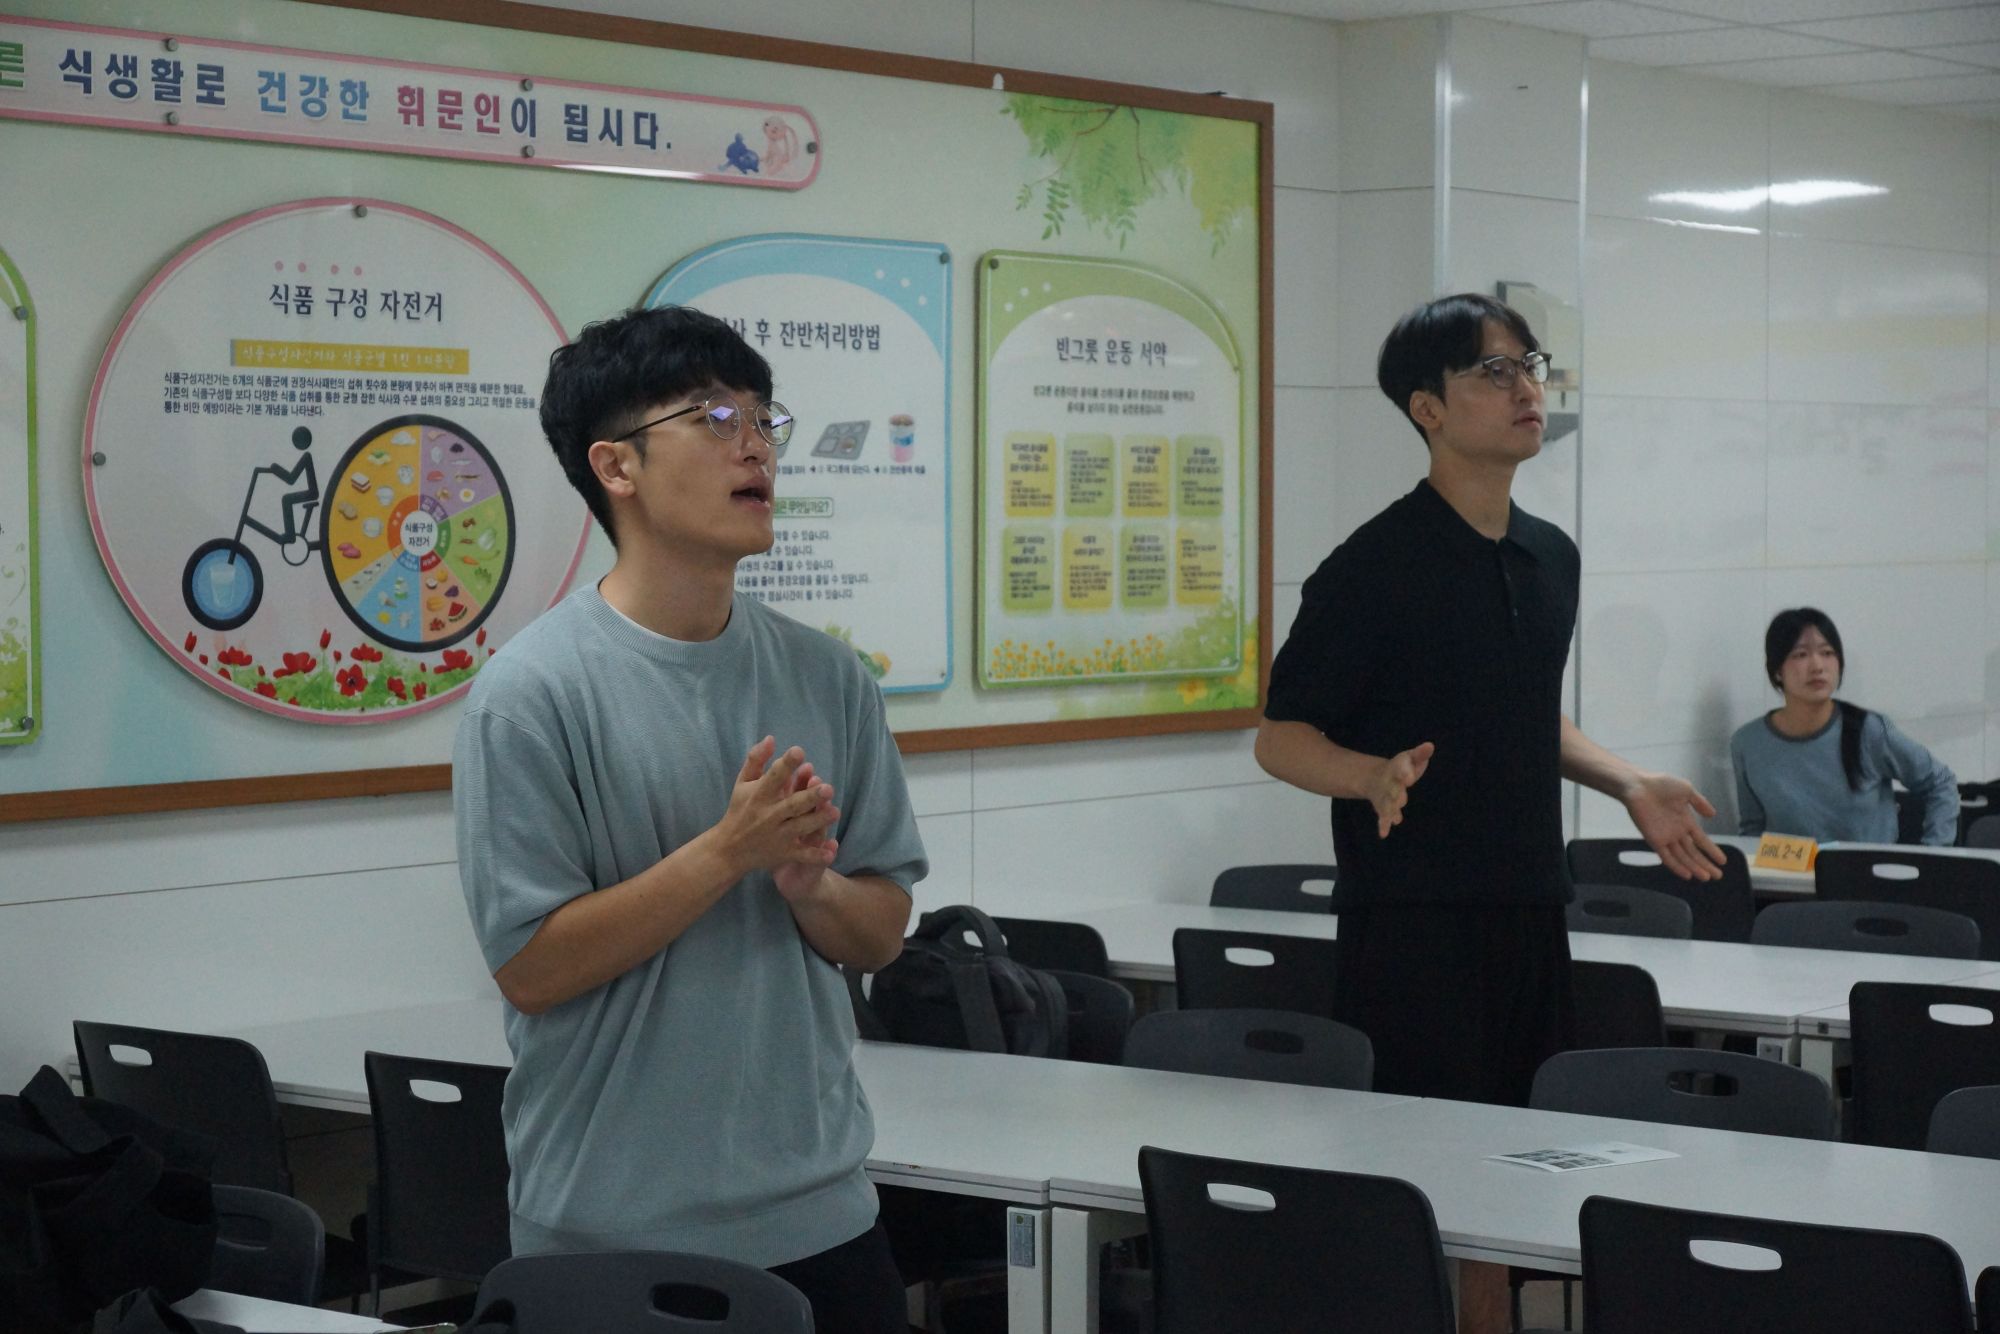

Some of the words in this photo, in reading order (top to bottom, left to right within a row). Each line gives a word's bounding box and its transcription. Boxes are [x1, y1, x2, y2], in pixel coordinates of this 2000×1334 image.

[59, 49, 225, 105] 식생활로
[257, 70, 369, 122] 건강한
[397, 85, 537, 138] 휘문인이
[564, 104, 672, 150] 됩시다.
[269, 284, 314, 315] 식품
[326, 288, 368, 319] 구성
[380, 290, 442, 322] 자전거
[755, 319, 771, 347] 후
[780, 320, 880, 350] 잔반처리방법
[1056, 337, 1097, 363] 빈그릇
[1105, 339, 1132, 365] 운동
[1141, 341, 1167, 367] 서약
[164, 372, 230, 386] 식품구성자전거는
[232, 374, 254, 387] 6개의
[256, 375, 288, 389] 식품군에
[164, 387, 189, 400] 기존의
[235, 389, 251, 401] 보다
[254, 390, 278, 401] 다양한
[281, 390, 297, 402] 식품
[164, 401, 180, 413] 통한
[184, 402, 200, 414] 비만
[246, 403, 262, 415] 기본
[265, 404, 288, 416] 개념을
